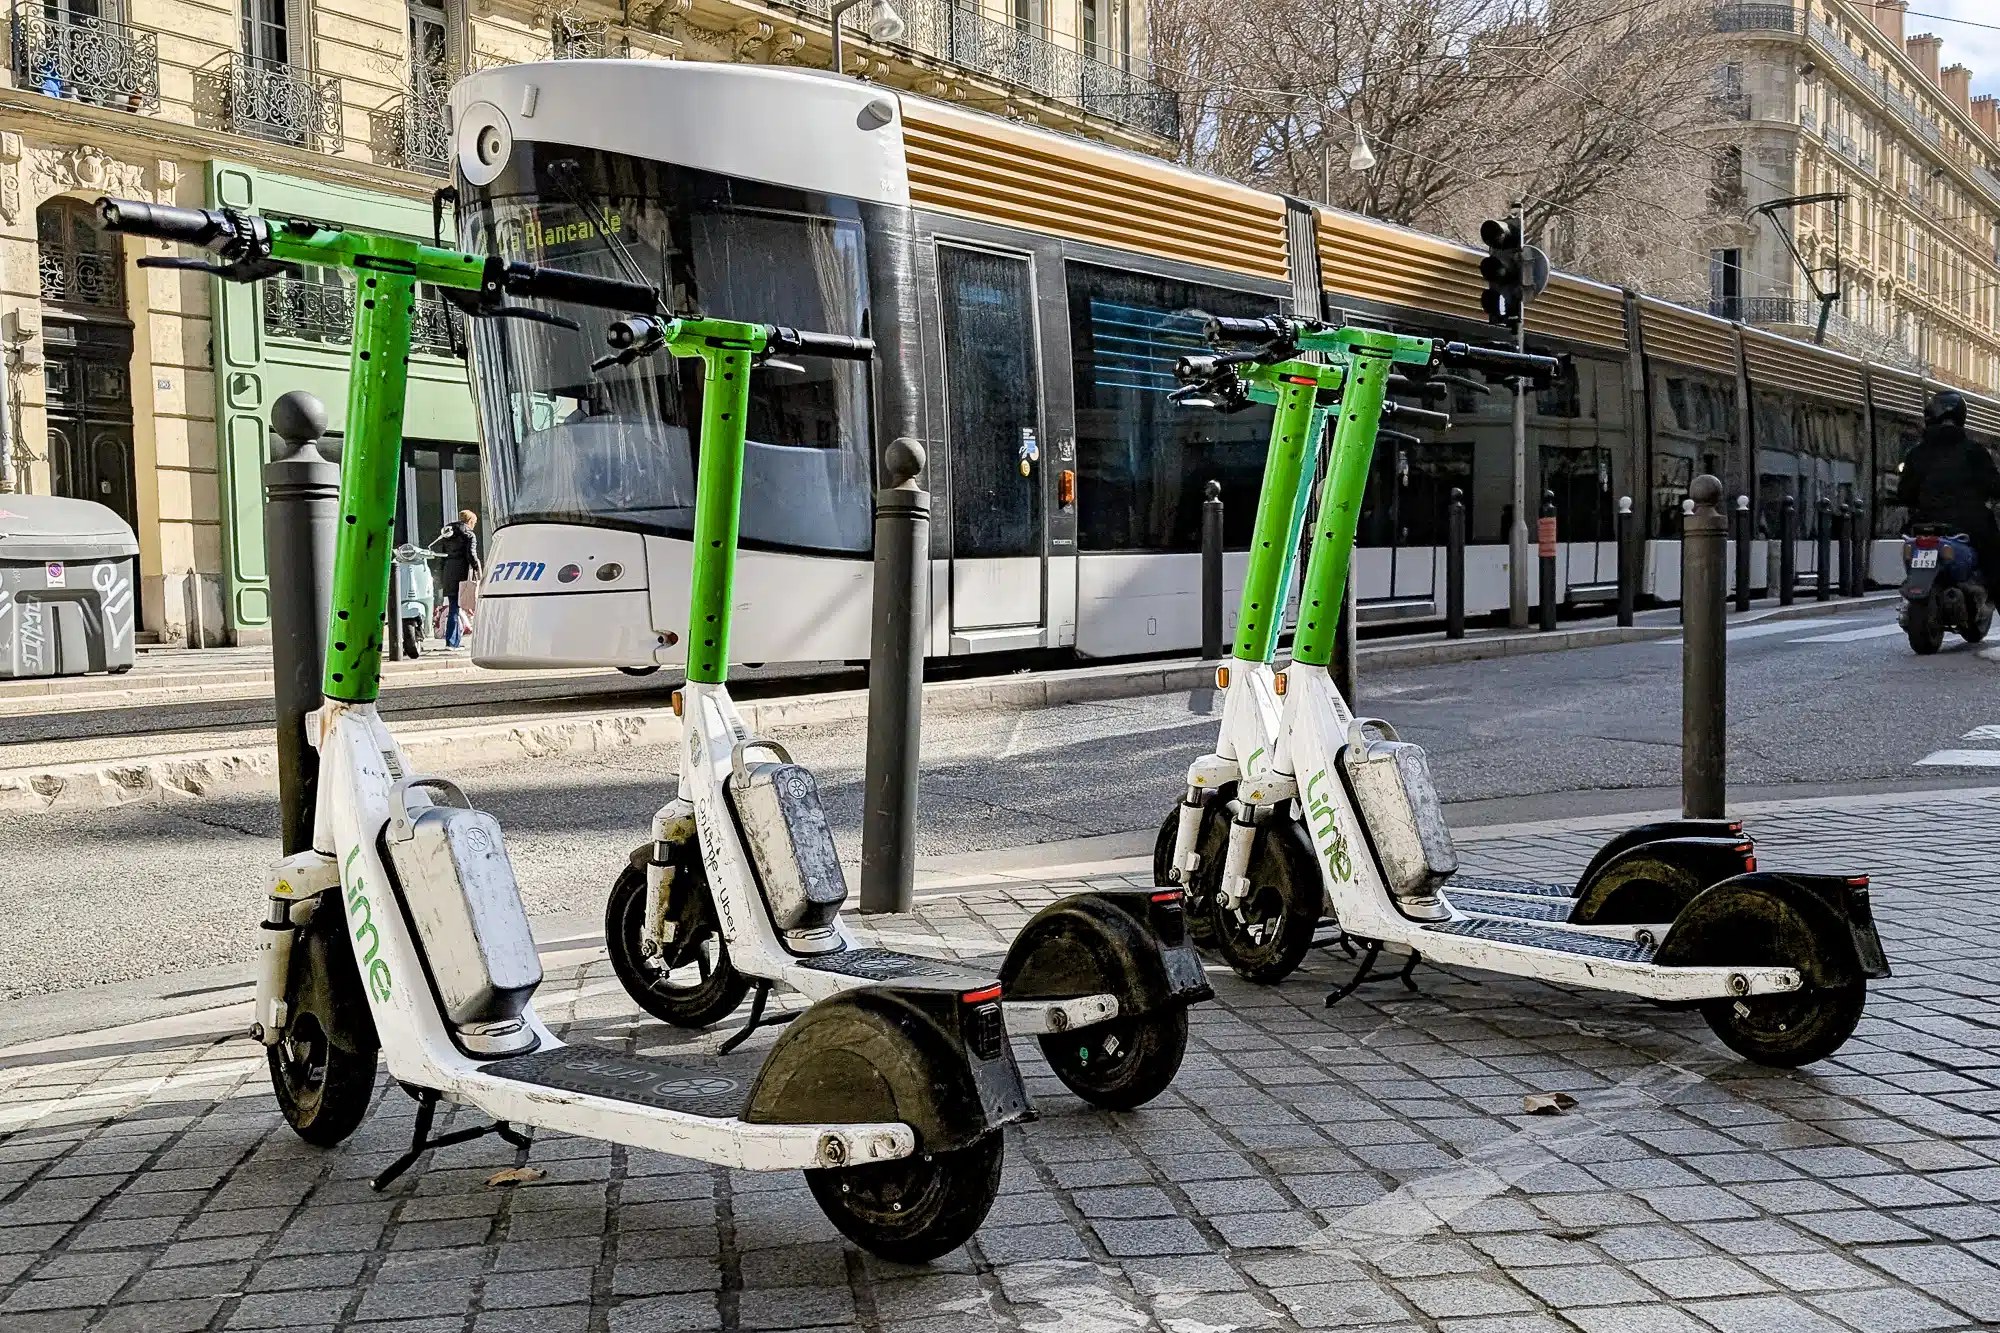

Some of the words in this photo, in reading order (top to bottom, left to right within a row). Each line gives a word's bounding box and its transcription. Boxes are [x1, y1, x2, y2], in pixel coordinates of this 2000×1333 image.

[490, 561, 546, 583] RTM
[1307, 769, 1352, 884] Lime
[345, 844, 392, 1004] Lime
[719, 887, 736, 932] Uber
